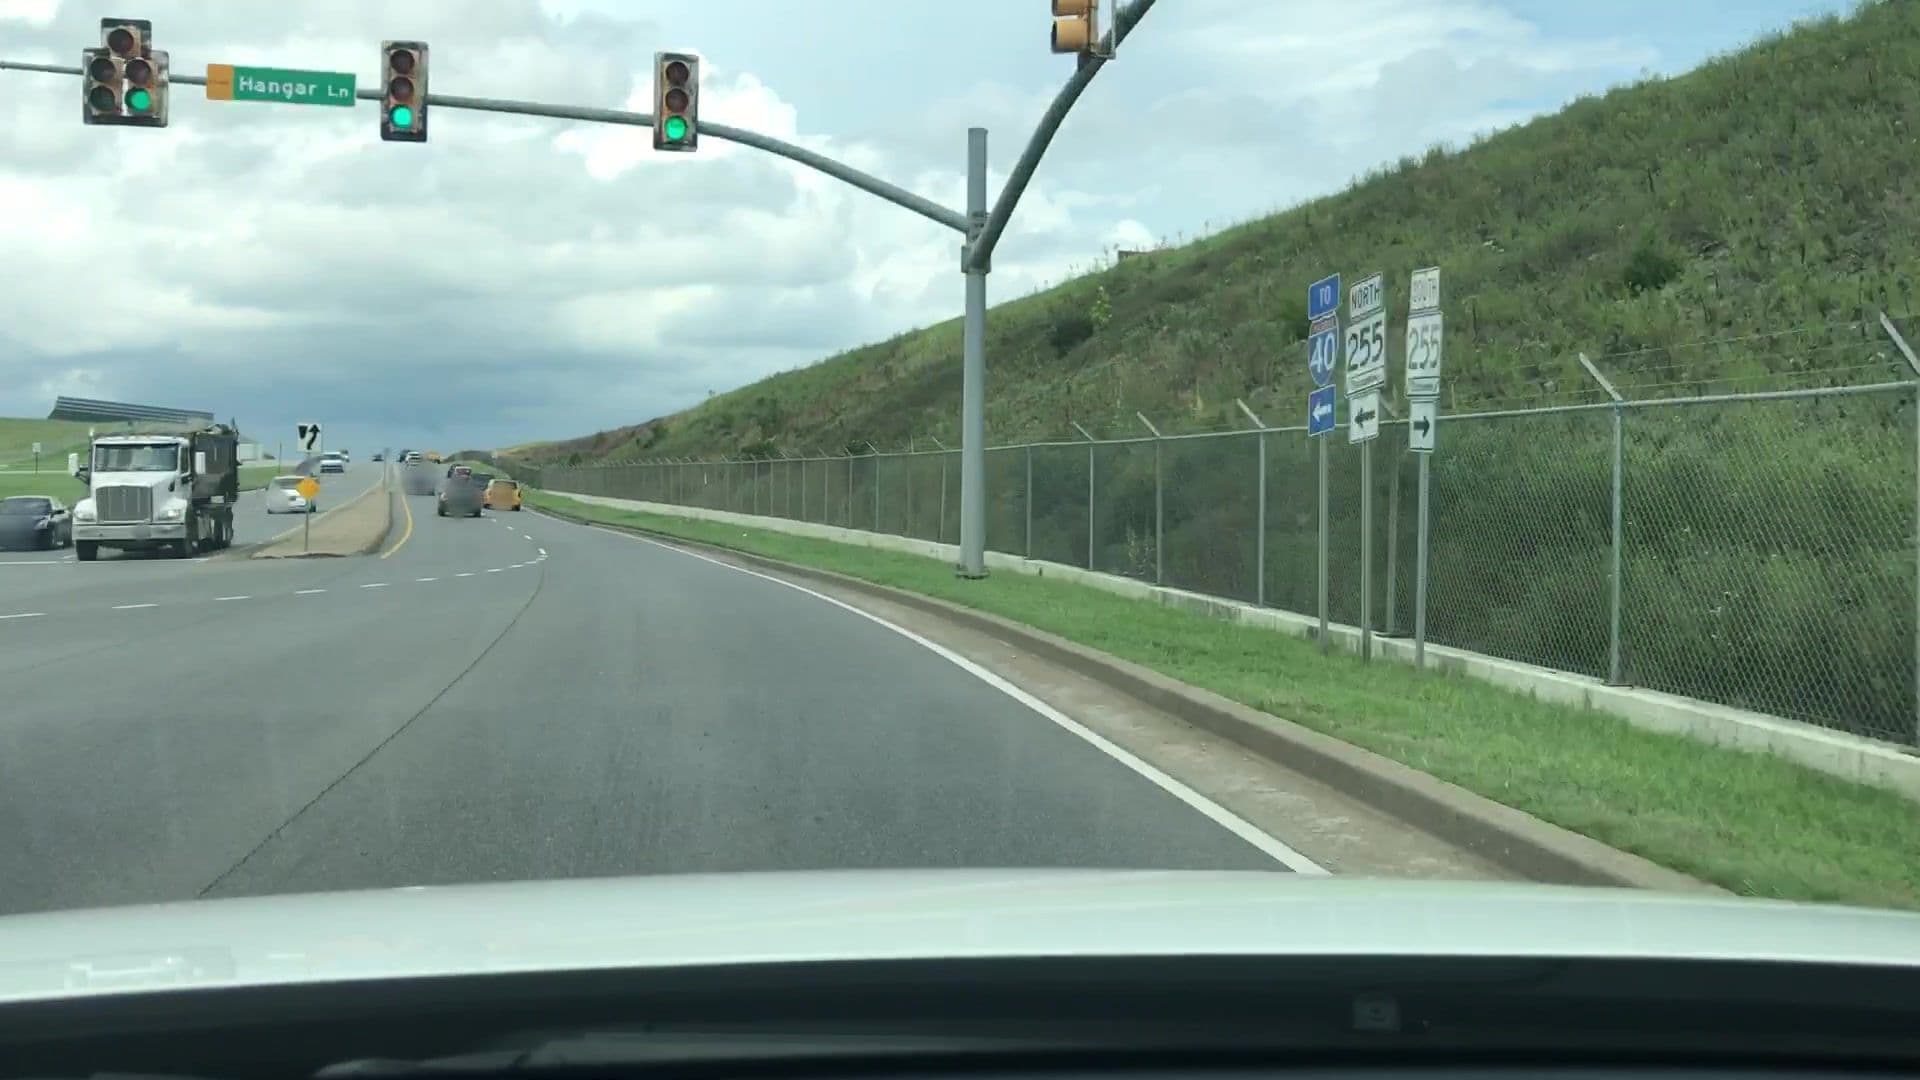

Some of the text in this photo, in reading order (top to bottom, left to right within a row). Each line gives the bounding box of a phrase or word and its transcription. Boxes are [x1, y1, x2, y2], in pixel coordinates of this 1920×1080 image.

[238, 76, 349, 99] Hangar Ln
[1351, 283, 1381, 310] NORTH
[1309, 332, 1336, 373] 40
[1347, 321, 1383, 372] 255
[1408, 323, 1440, 370] 255
